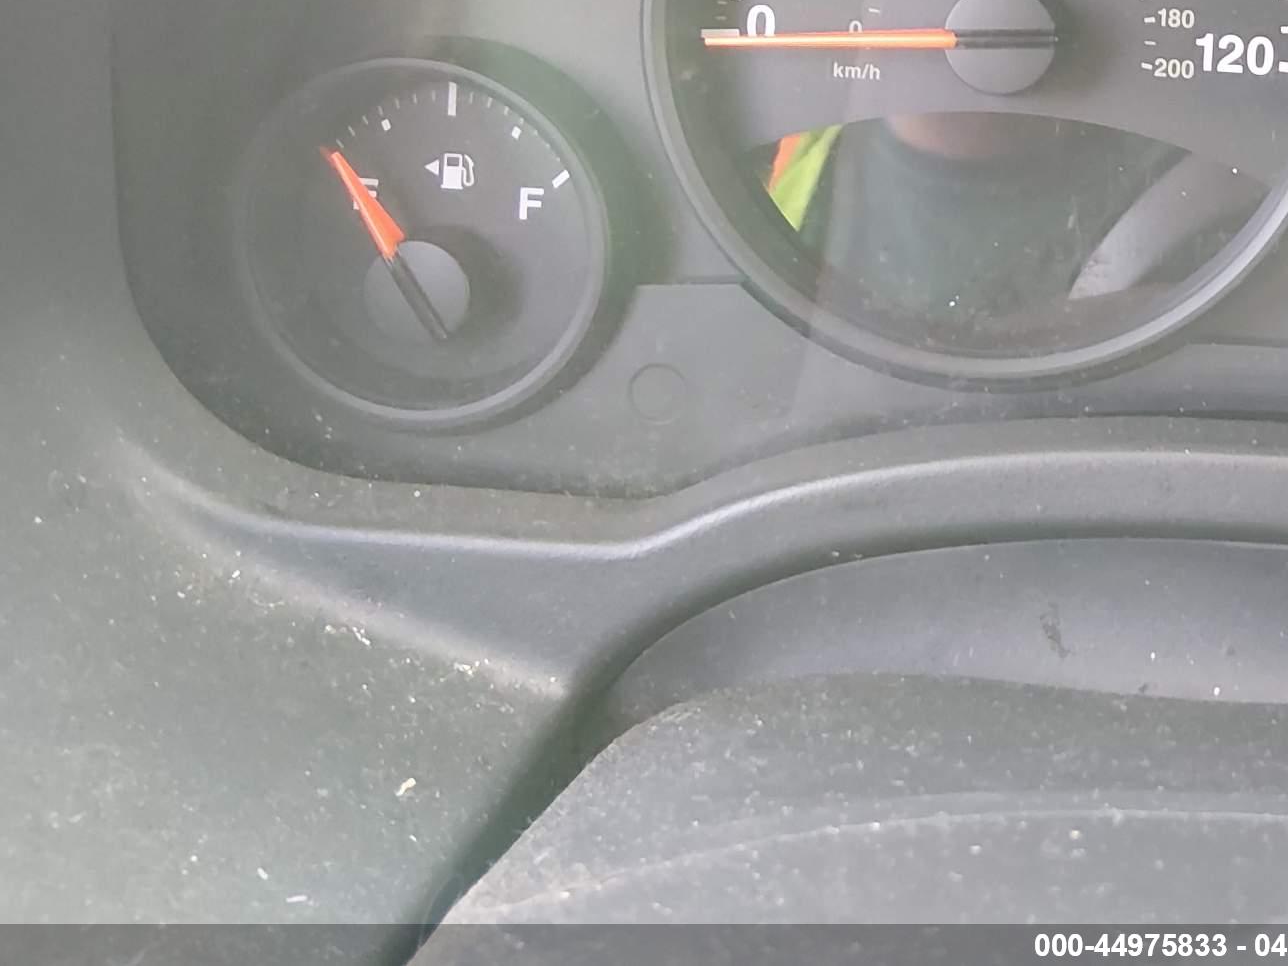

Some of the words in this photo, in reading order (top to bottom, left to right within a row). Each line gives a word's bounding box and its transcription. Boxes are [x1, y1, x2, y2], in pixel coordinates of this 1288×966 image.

[746, 5, 776, 36] 0
[1156, 8, 1195, 29] 180
[1195, 33, 1274, 76] 120
[833, 62, 880, 81] km/h
[1153, 58, 1195, 80] 200
[519, 187, 544, 220] F
